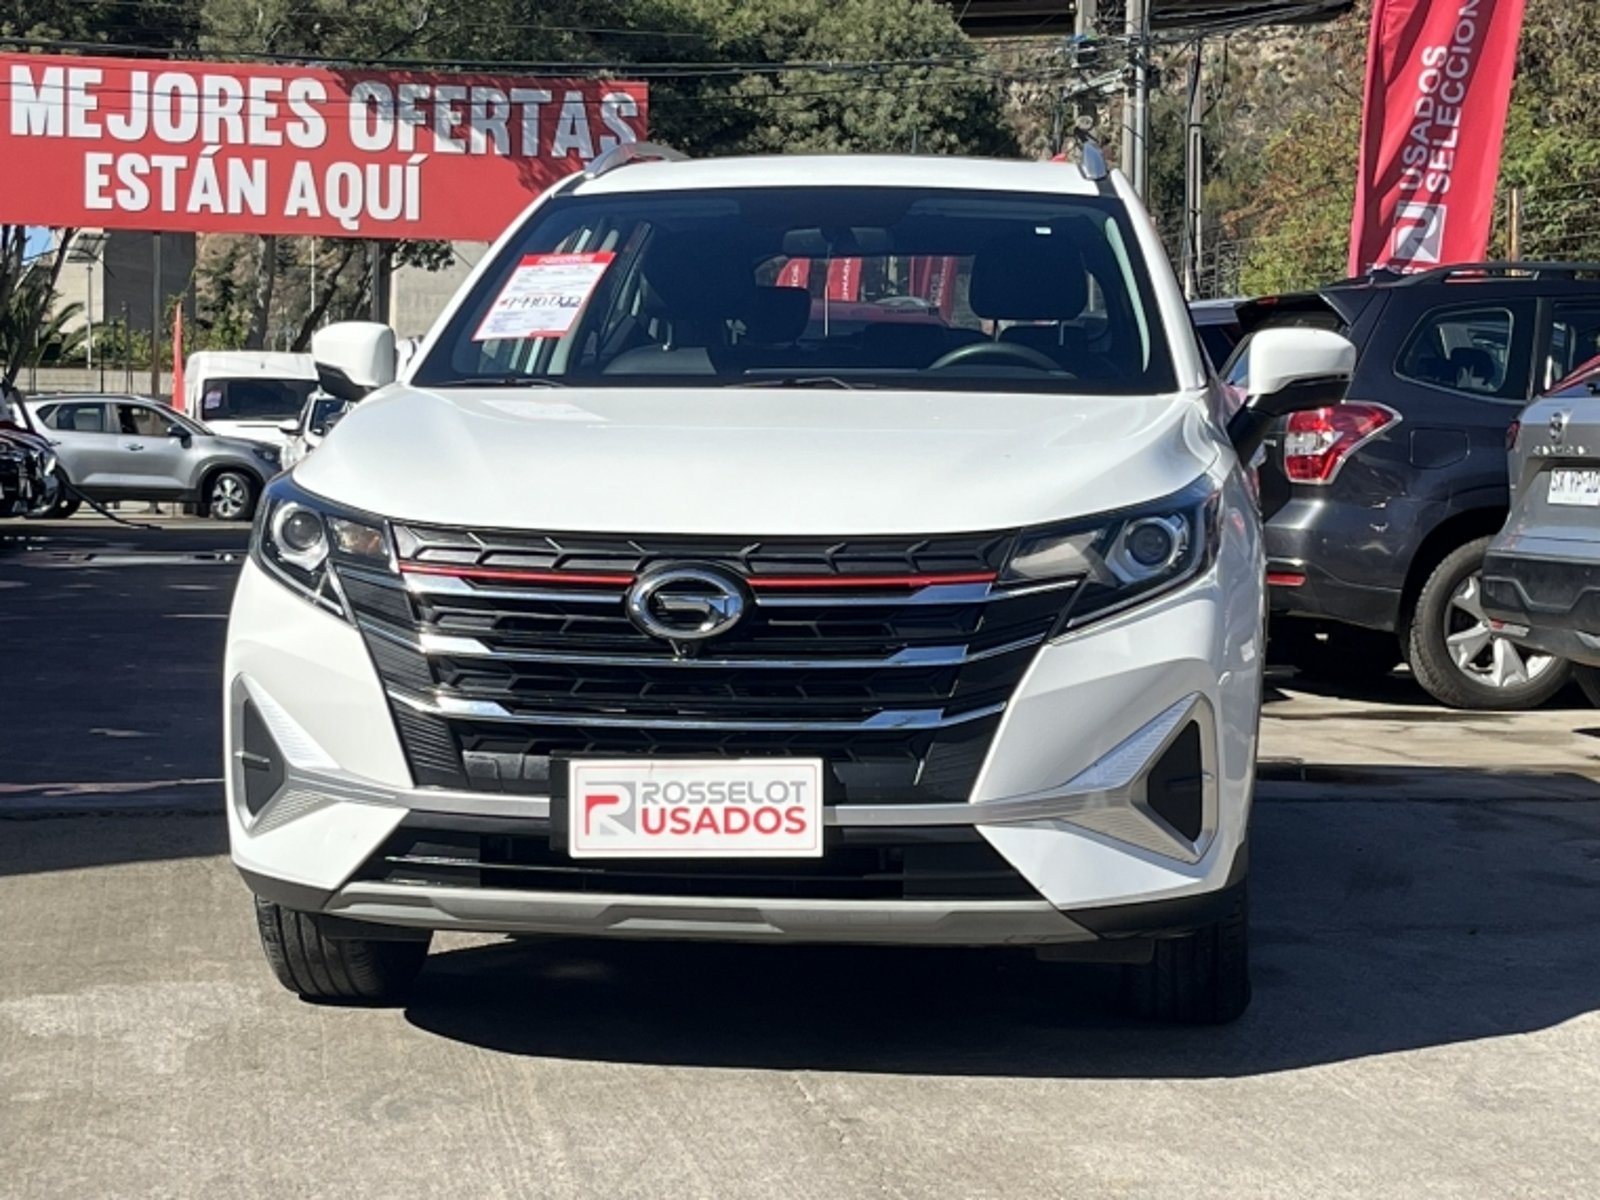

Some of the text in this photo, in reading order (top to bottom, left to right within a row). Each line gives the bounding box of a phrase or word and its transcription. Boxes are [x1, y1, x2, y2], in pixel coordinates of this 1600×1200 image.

[10, 65, 639, 160] MEJORES OFERTAS
[1400, 46, 1447, 190] USADOS
[85, 145, 427, 229] ESTÁN AQUÍ
[642, 781, 807, 804] ROSSELOT
[642, 806, 807, 835] USADOS
